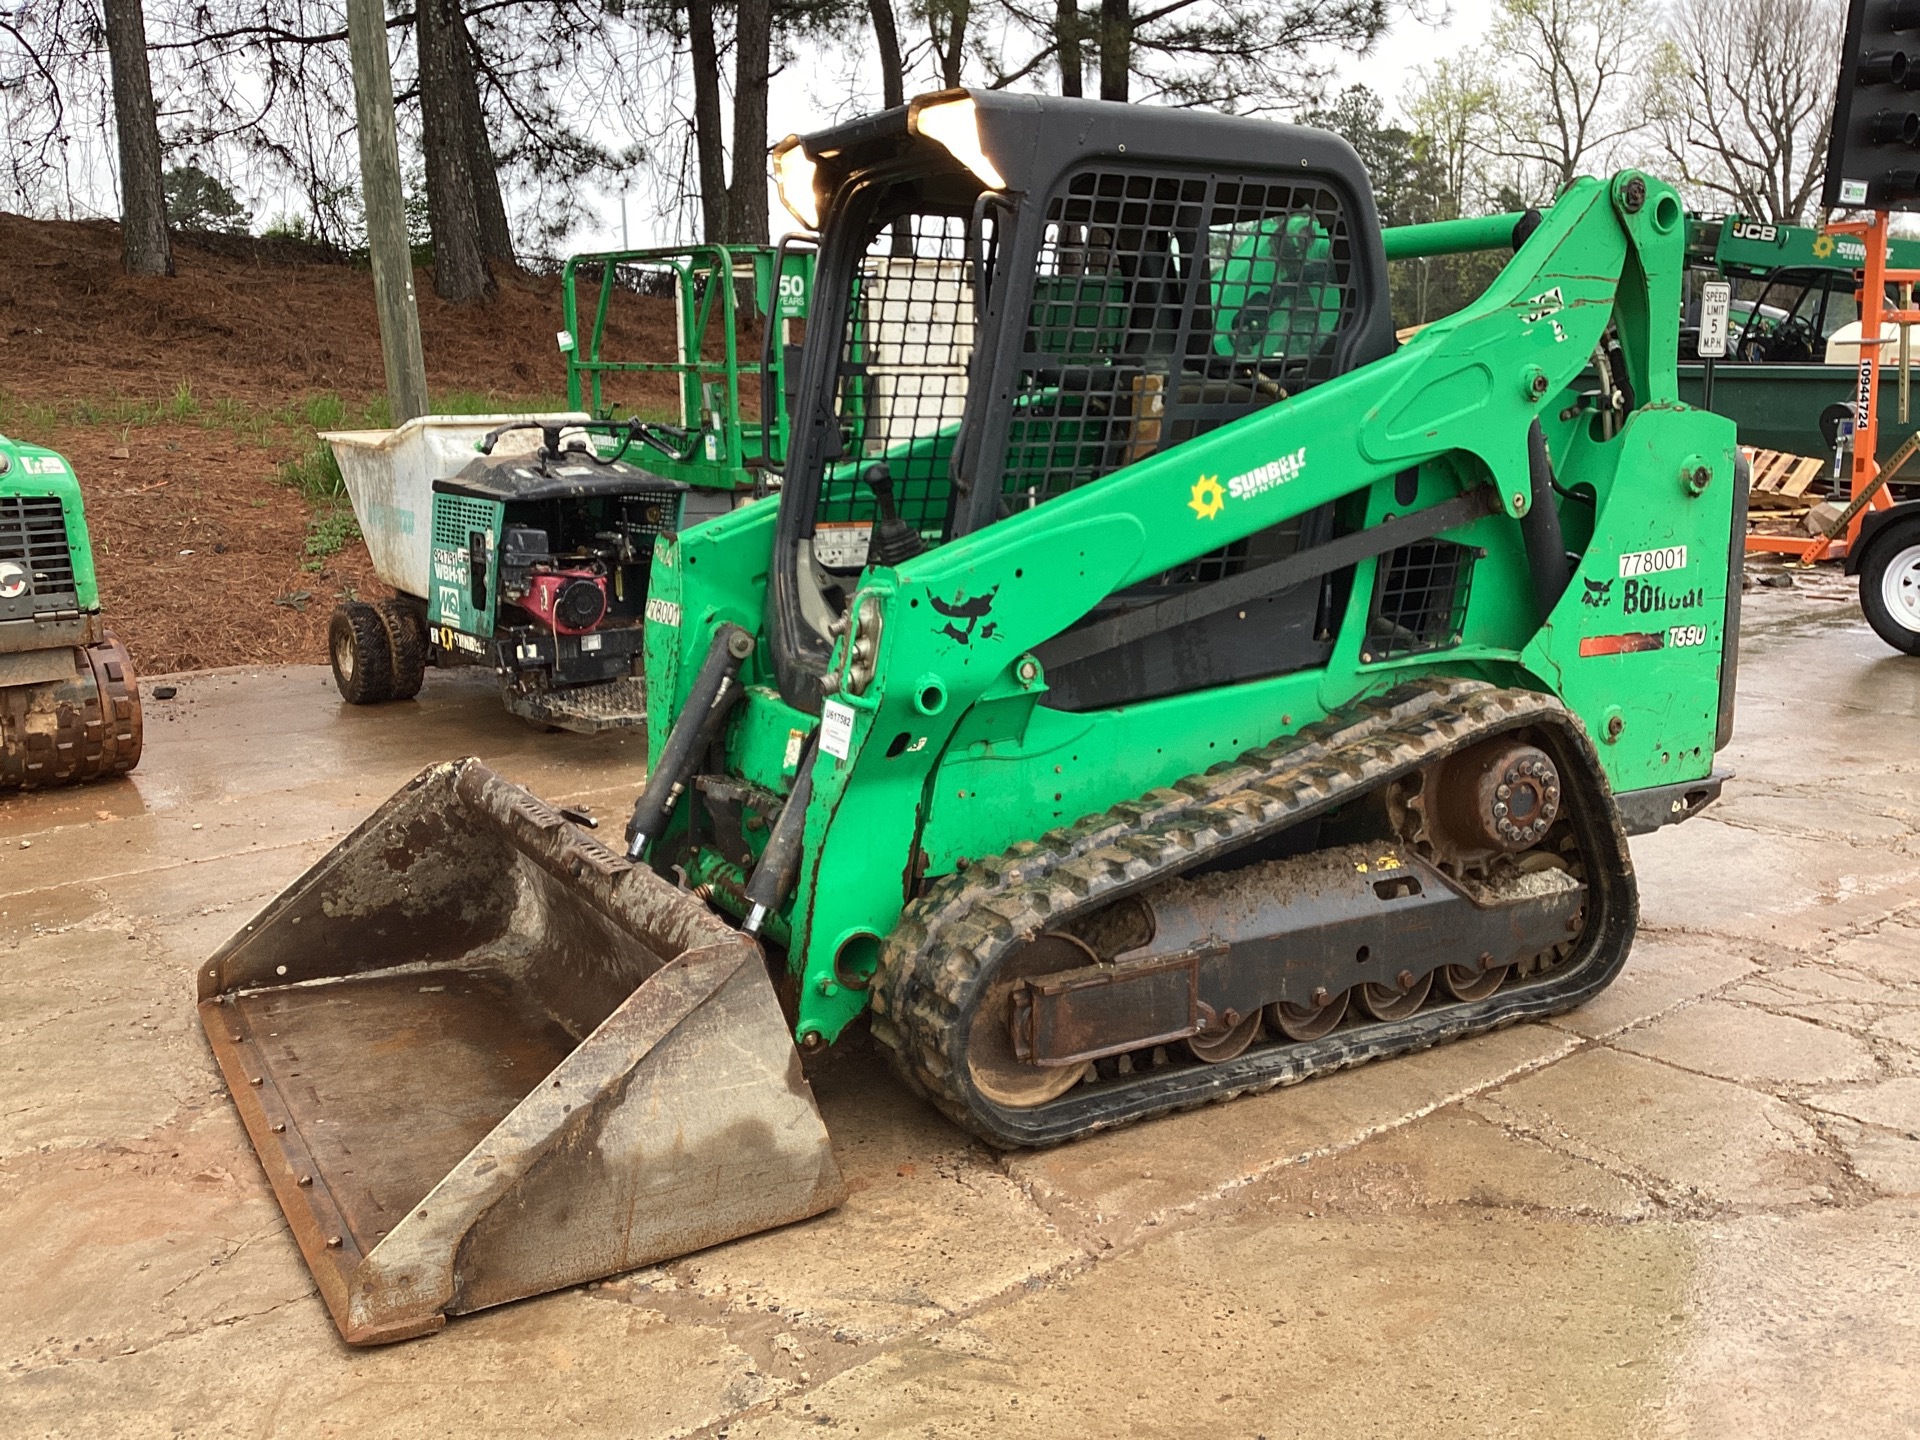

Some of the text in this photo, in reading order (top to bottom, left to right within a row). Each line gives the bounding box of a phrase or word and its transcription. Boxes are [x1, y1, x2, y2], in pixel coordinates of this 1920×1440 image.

[1732, 224, 1777, 242] JCB
[779, 274, 804, 297] 50
[1706, 291, 1727, 303] SPEED
[1706, 304, 1724, 316] LIMIT
[1711, 319, 1718, 334] 5
[1858, 360, 1872, 429] 10944724
[1621, 547, 1684, 577] 778001
[825, 708, 851, 727] U617582
